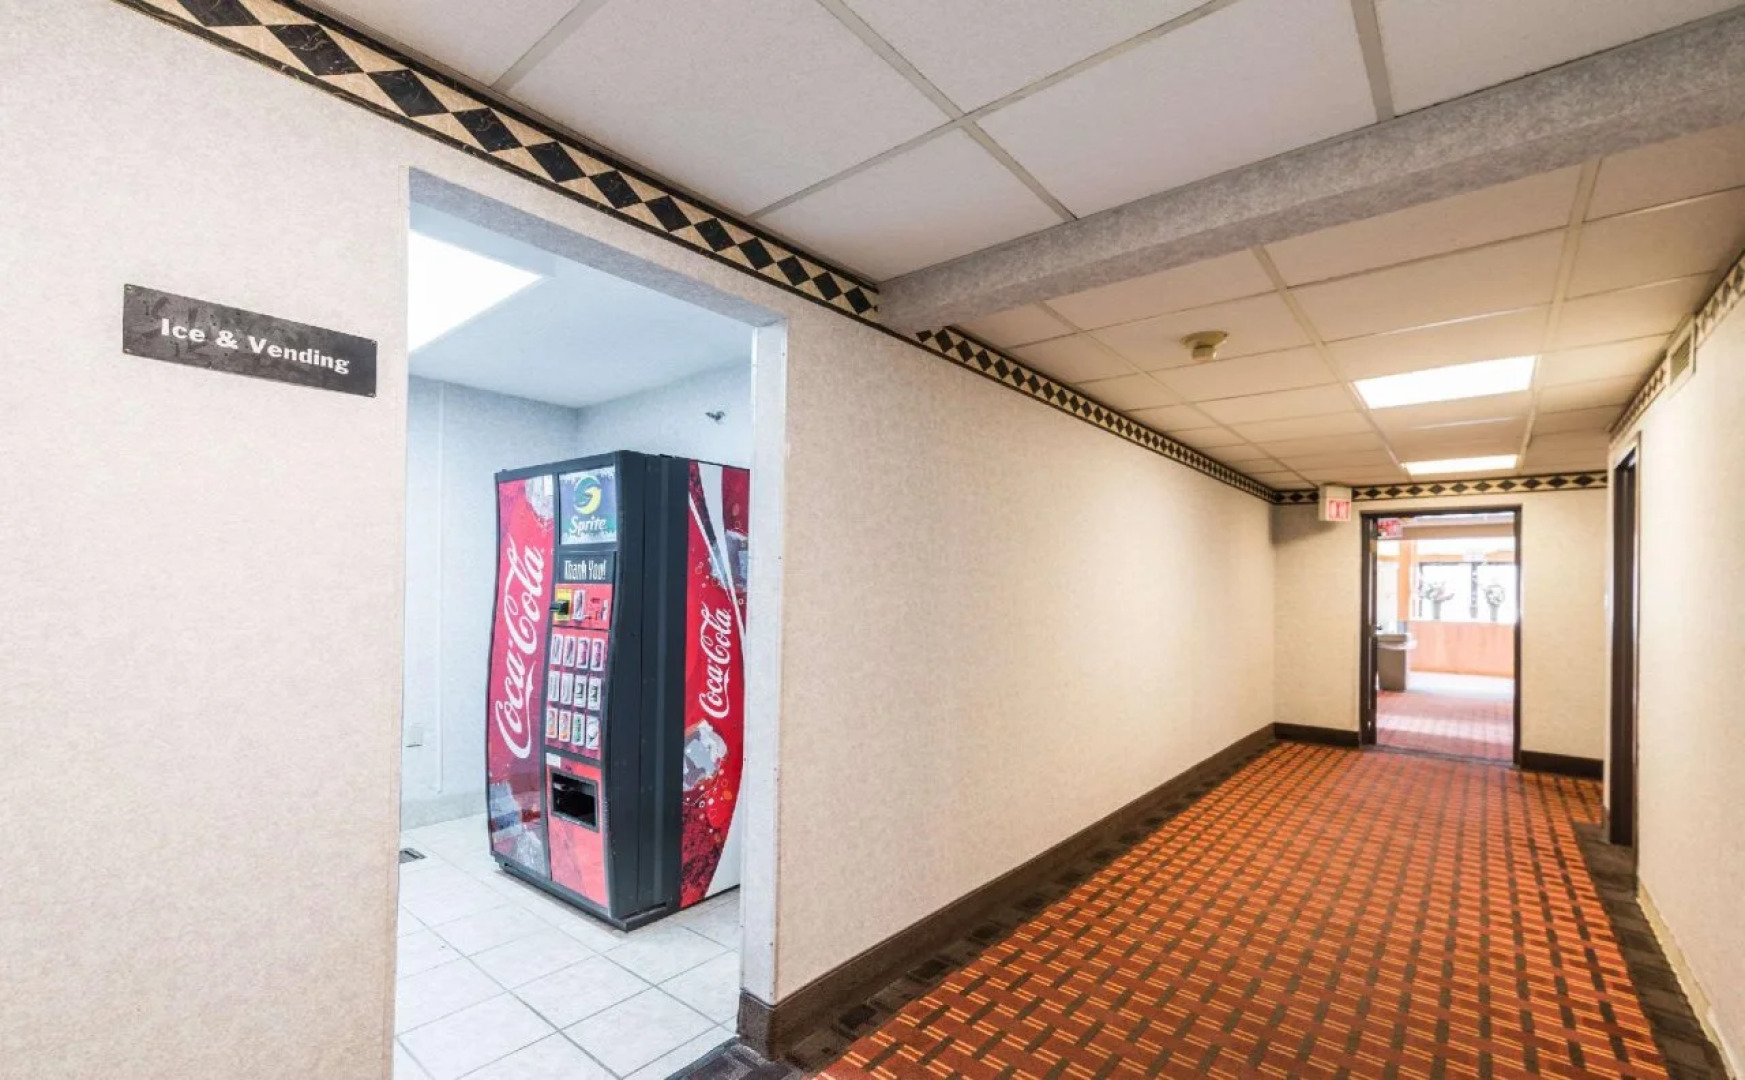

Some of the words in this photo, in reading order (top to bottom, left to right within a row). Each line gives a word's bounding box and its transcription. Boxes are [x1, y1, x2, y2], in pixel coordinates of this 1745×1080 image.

[160, 318, 205, 342] Ice
[215, 329, 239, 349] &
[248, 335, 350, 375] Vending
[569, 515, 607, 536] Sprite
[564, 560, 587, 581] Thank
[588, 559, 607, 580] You!
